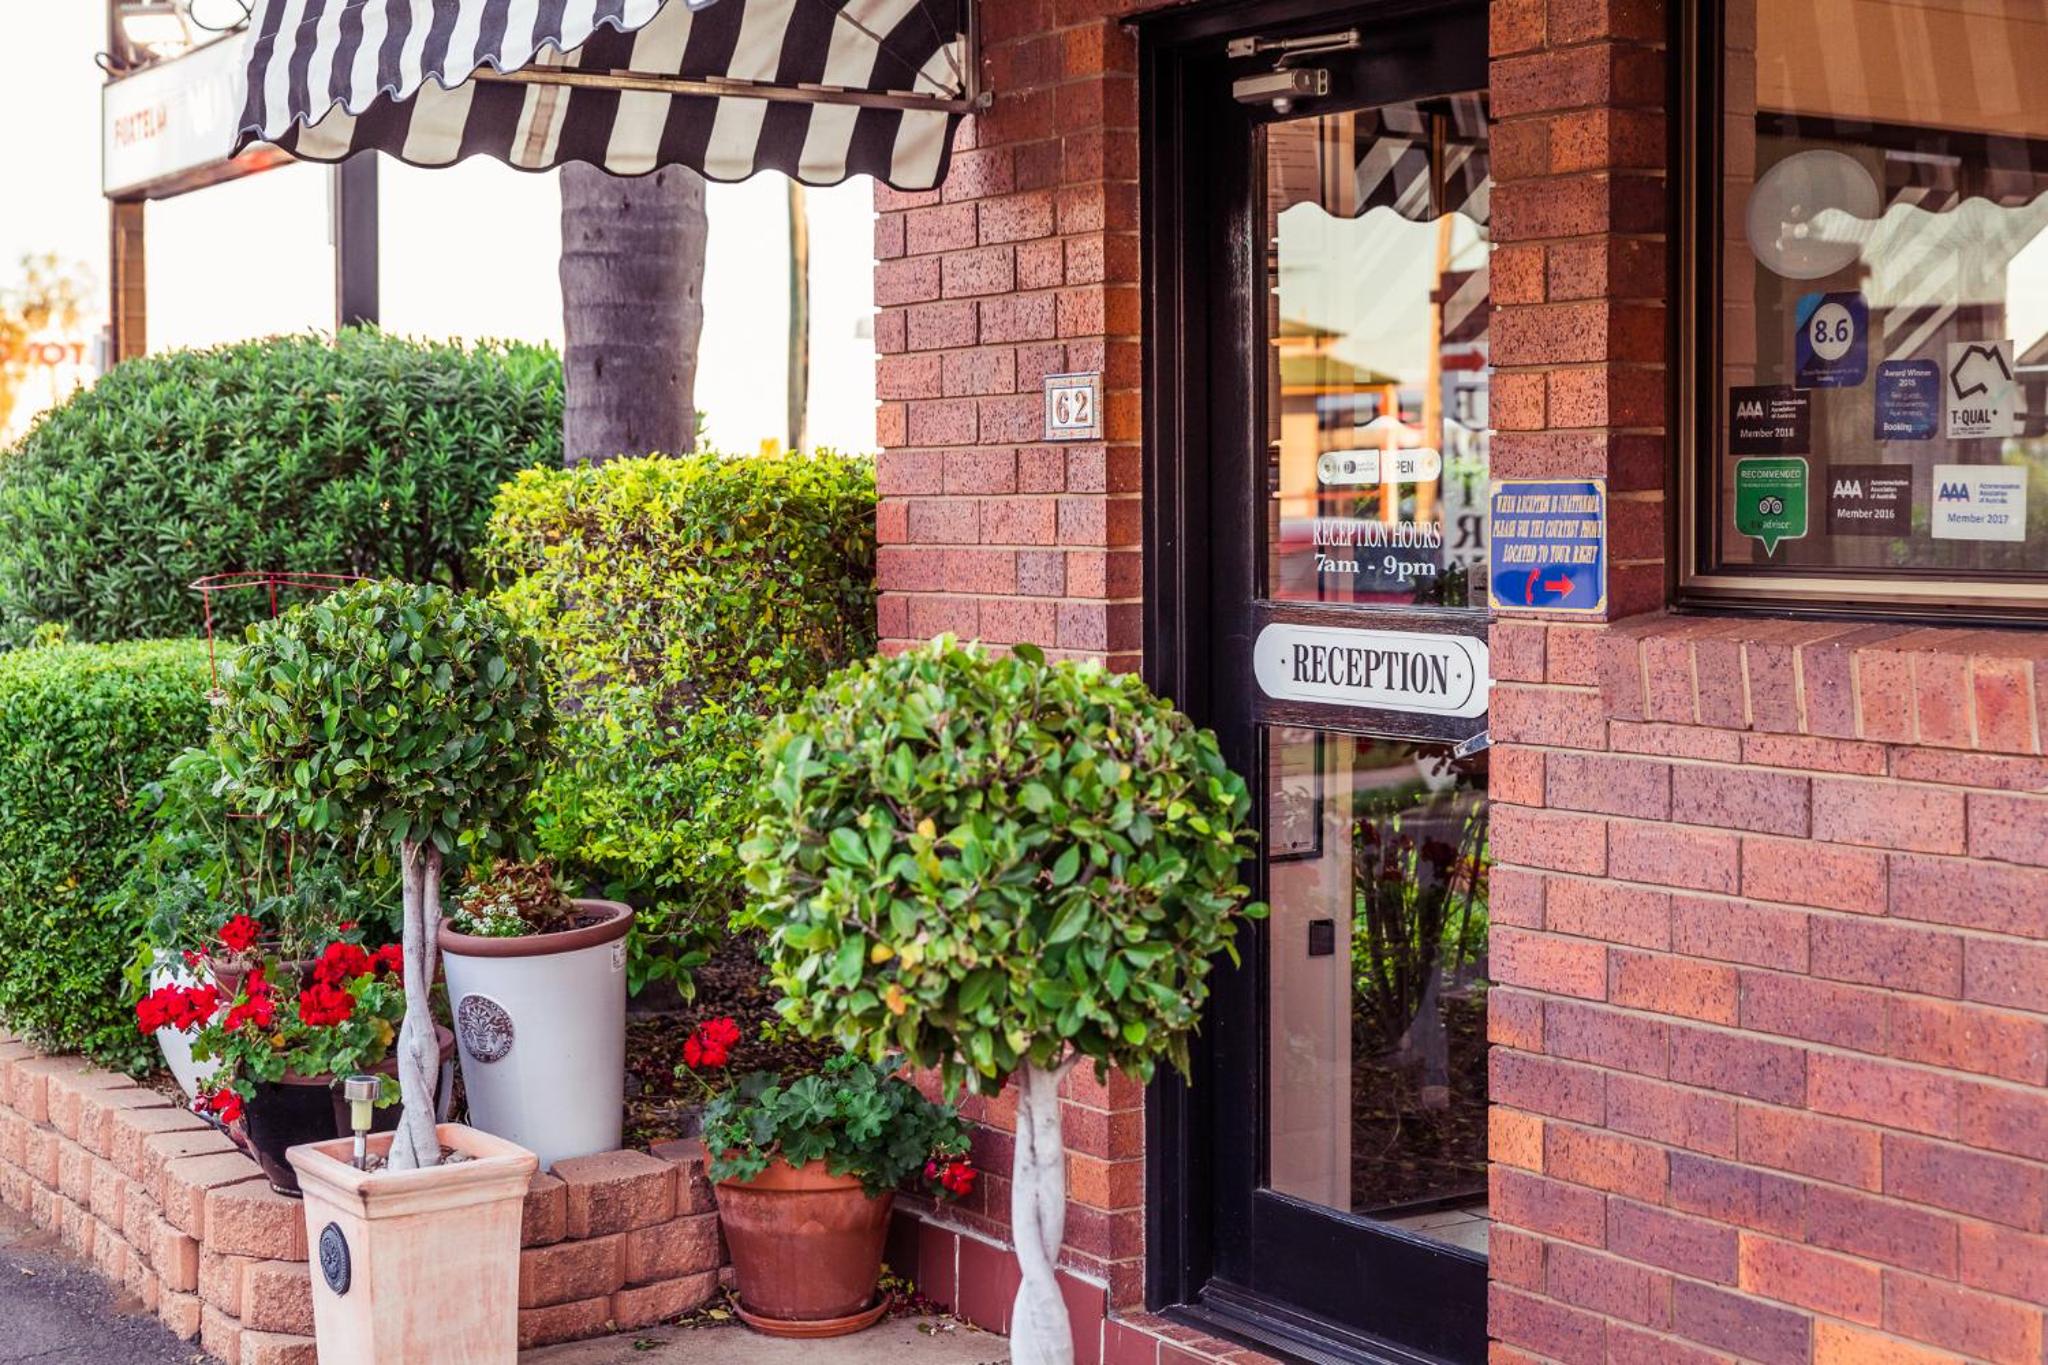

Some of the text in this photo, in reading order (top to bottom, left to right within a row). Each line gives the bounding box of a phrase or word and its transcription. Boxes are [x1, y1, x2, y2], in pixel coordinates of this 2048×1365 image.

[1815, 318, 1848, 343] 8.6
[1056, 390, 1088, 424] 62
[1736, 400, 1763, 419] AAA
[1951, 409, 1991, 426] T-QUAL
[1740, 428, 1773, 438] Member
[1741, 470, 1801, 478] RECOMMENDED
[1833, 480, 1863, 499] AAA
[1939, 482, 1970, 502] AAA
[1837, 508, 1895, 519] Member 2016
[1947, 513, 2009, 524] Member 2017
[1312, 520, 1441, 549] RECEPTION HOURS
[1502, 544, 1598, 564] LOCATED TO YOUR RIGHT
[1314, 553, 1360, 573] 7am
[1383, 555, 1436, 582] 9pm
[1292, 643, 1449, 695] RECEPTION
